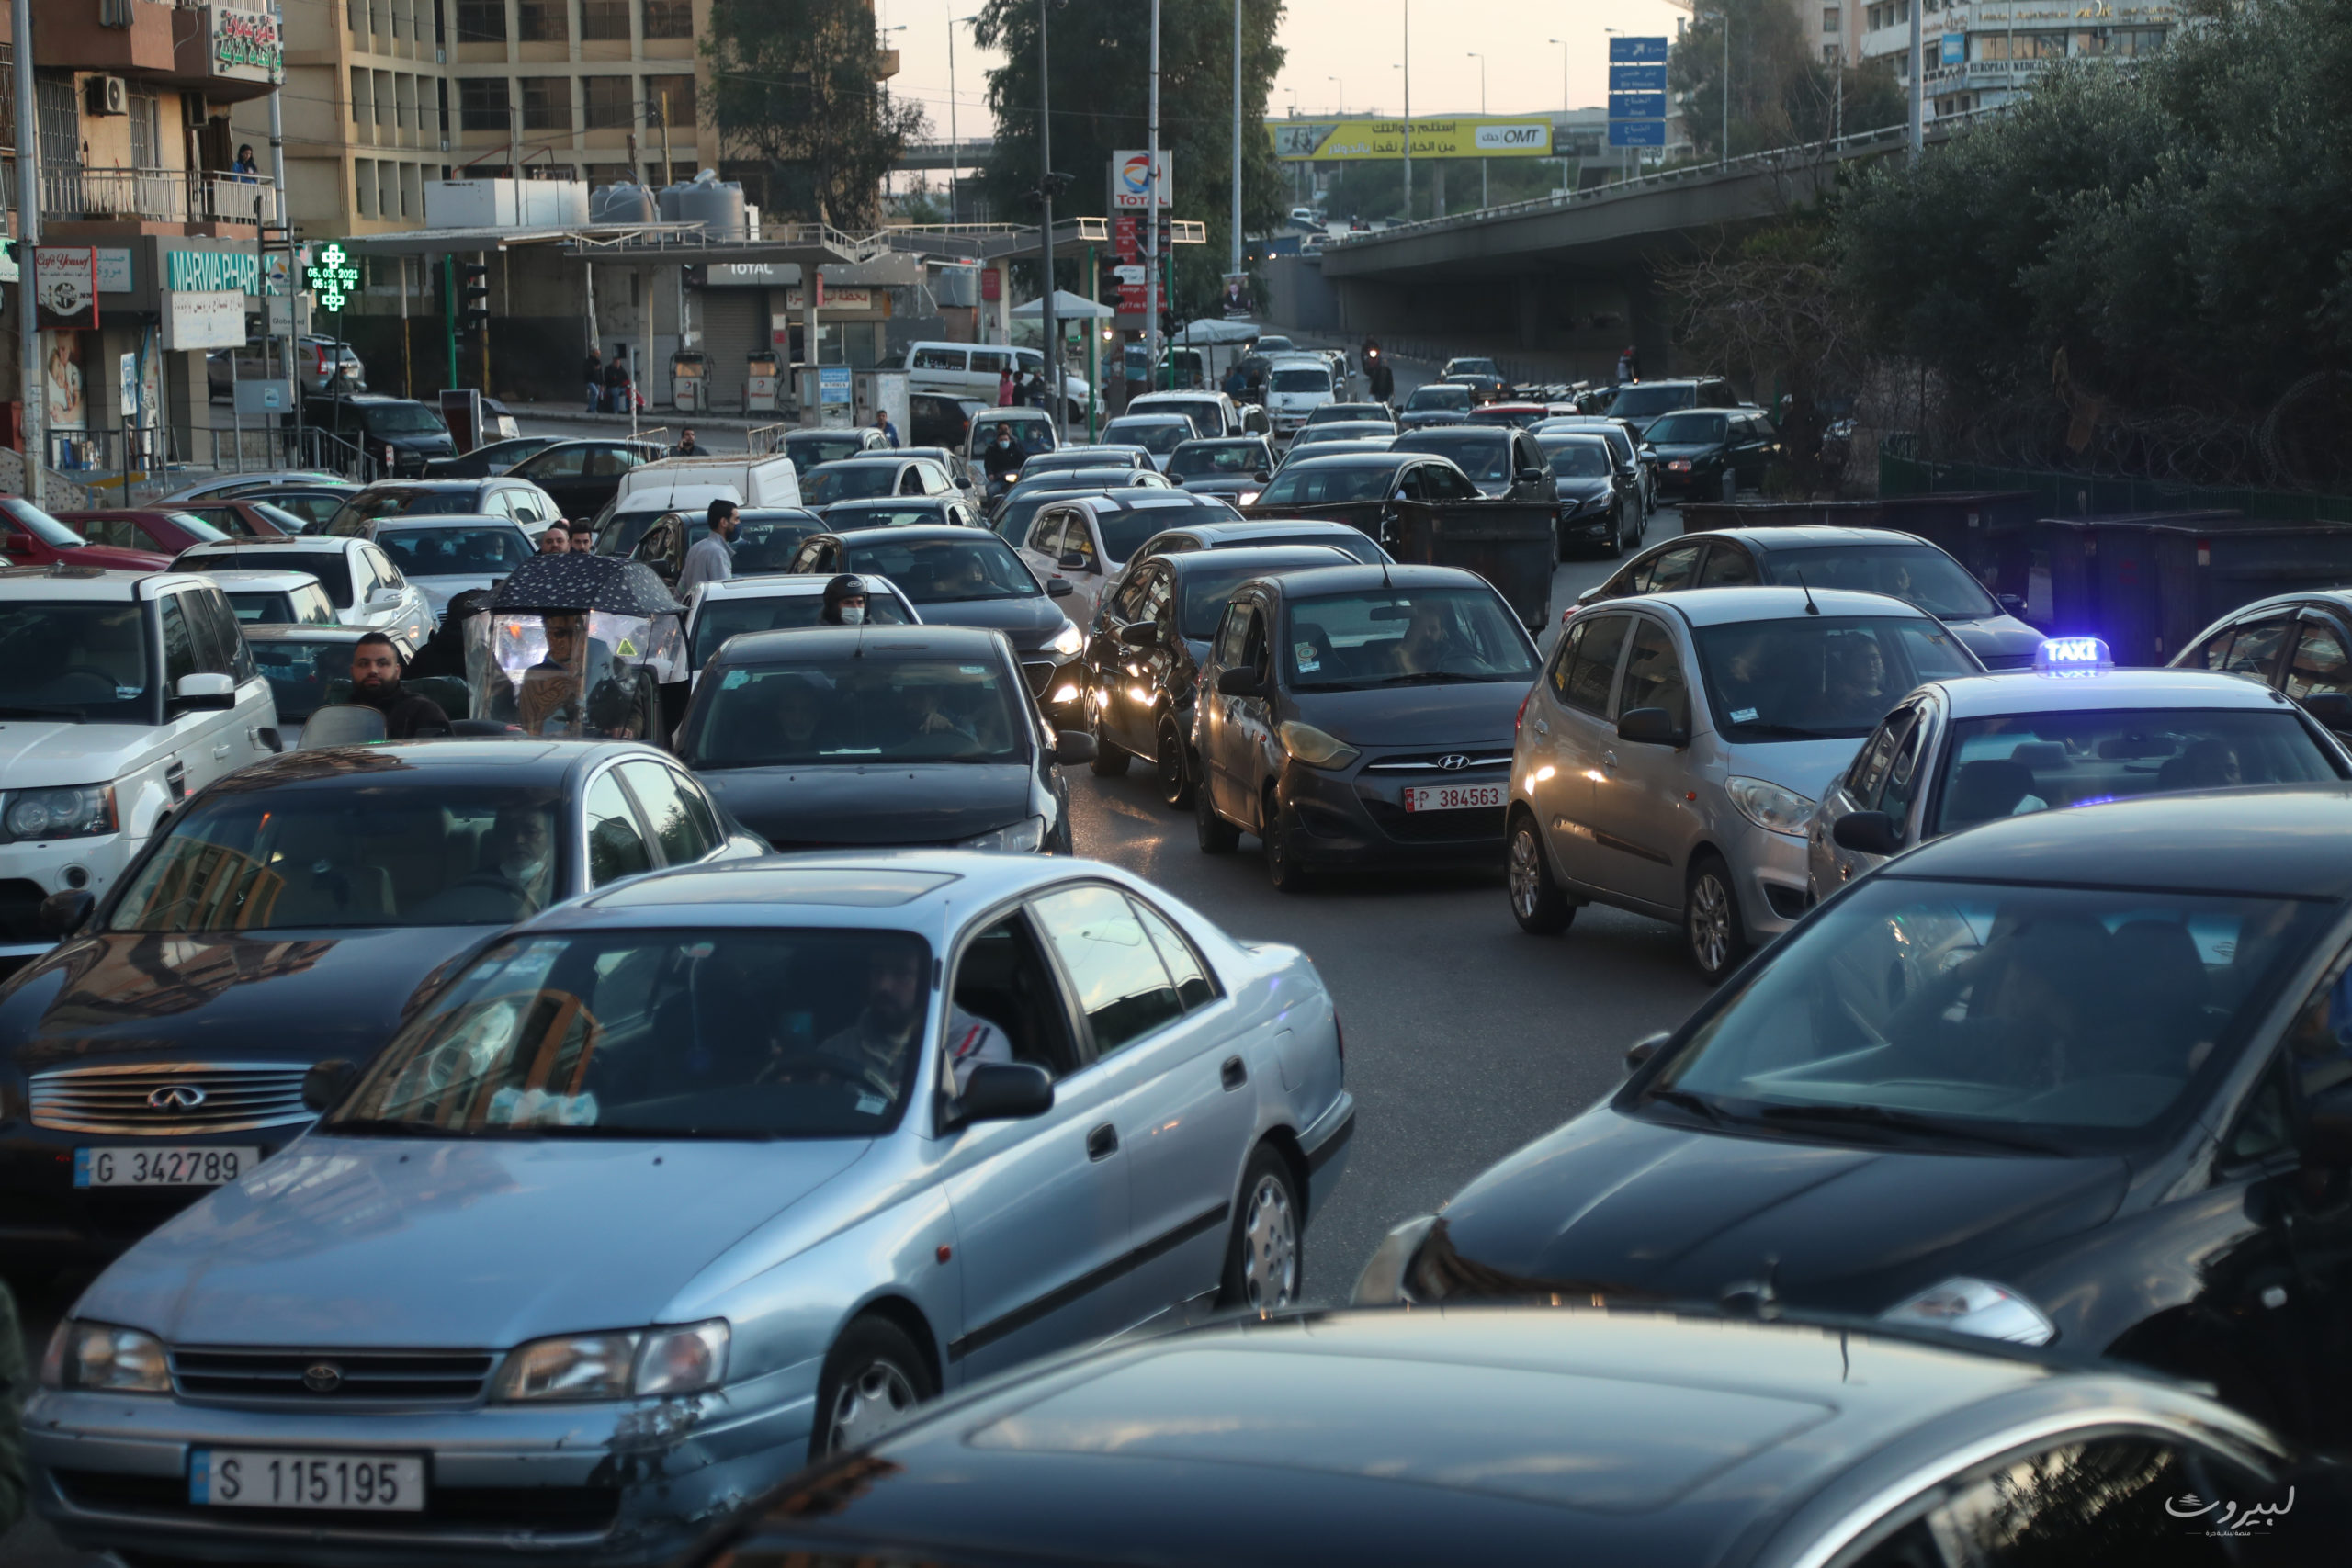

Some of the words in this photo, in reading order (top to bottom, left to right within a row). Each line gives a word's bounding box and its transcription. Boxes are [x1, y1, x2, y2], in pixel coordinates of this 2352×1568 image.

[1970, 62, 2009, 73] EUROPEAN
[2014, 62, 2045, 72] MEDICA
[1418, 122, 1455, 135] إستلم
[1504, 129, 1539, 143] OMT
[1329, 142, 1371, 156] بالدولار
[1438, 141, 1455, 152] من
[1117, 194, 1168, 205] TOTL
[57, 253, 90, 270] Youssef
[96, 251, 126, 265] صيدل
[343, 279, 354, 289] PM
[2044, 641, 2097, 661] TAXI
[1419, 790, 1430, 808] P
[1440, 787, 1498, 807] 384563
[97, 1153, 114, 1183] G
[132, 1152, 240, 1183] 342789
[220, 1459, 241, 1500] S
[269, 1460, 399, 1505] 115195
